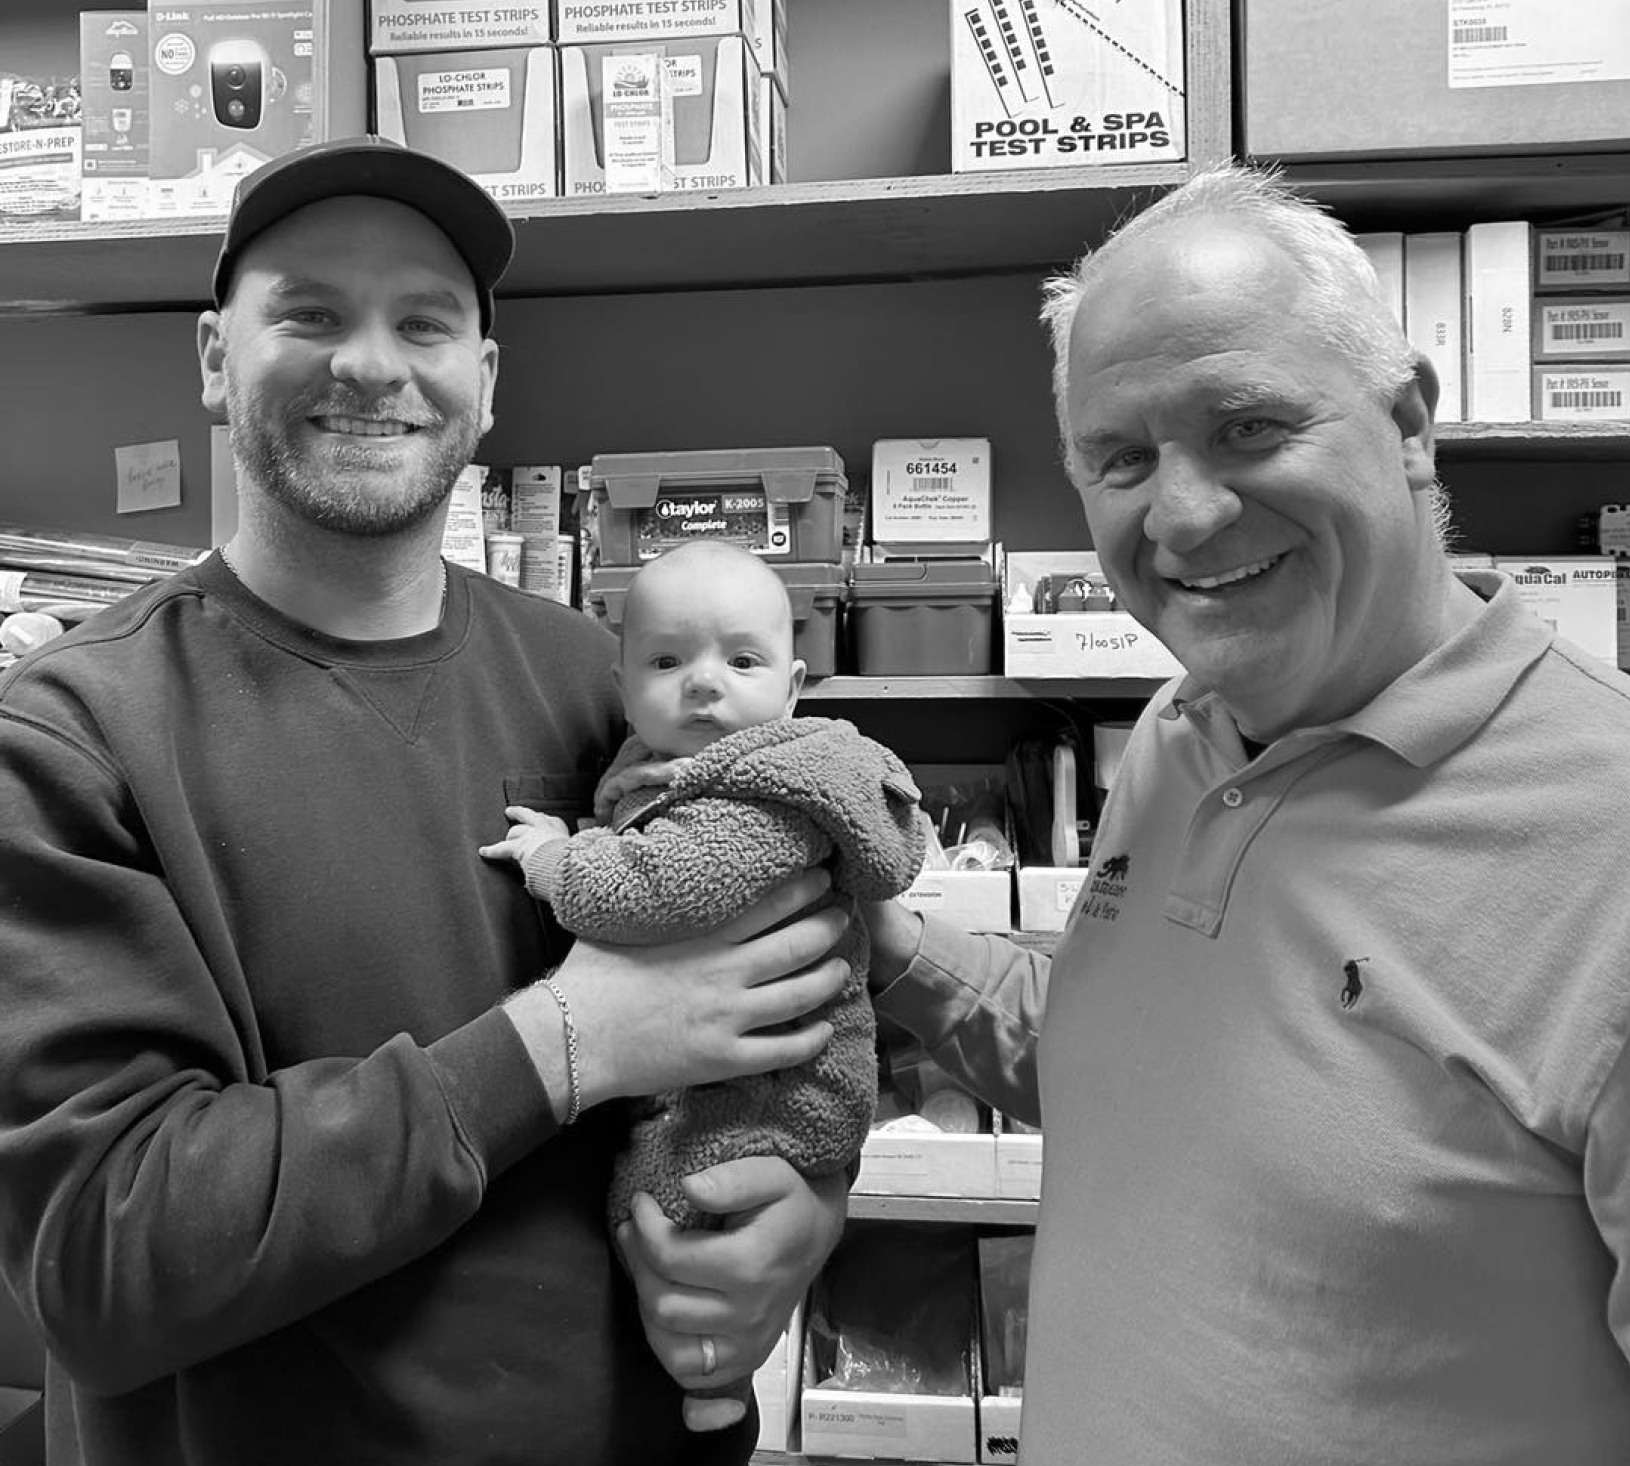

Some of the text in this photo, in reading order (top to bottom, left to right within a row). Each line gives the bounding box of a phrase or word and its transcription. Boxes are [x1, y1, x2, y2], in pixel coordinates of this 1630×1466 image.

[156, 12, 190, 21] D-Link
[564, 0, 727, 19] PHOSPHATE TEST STRIPS
[378, 9, 539, 27] PHOSPHATE TEST STRIPS
[576, 16, 716, 33] Reliable results in 15 seconds!
[390, 26, 528, 41] Reliable results in 15 seconds!
[439, 72, 485, 83] LO-CHLOR
[422, 81, 504, 95] PHOSPHATE STRIPS
[975, 112, 1166, 138] POOL & SPA
[970, 131, 1170, 158] TEST STRIPS
[691, 175, 737, 188] STRIPS
[501, 182, 547, 196] STRIPS
[906, 462, 957, 474] 661454
[669, 499, 717, 518] taylor
[681, 518, 727, 532] Complete
[1514, 572, 1567, 585] quaCal
